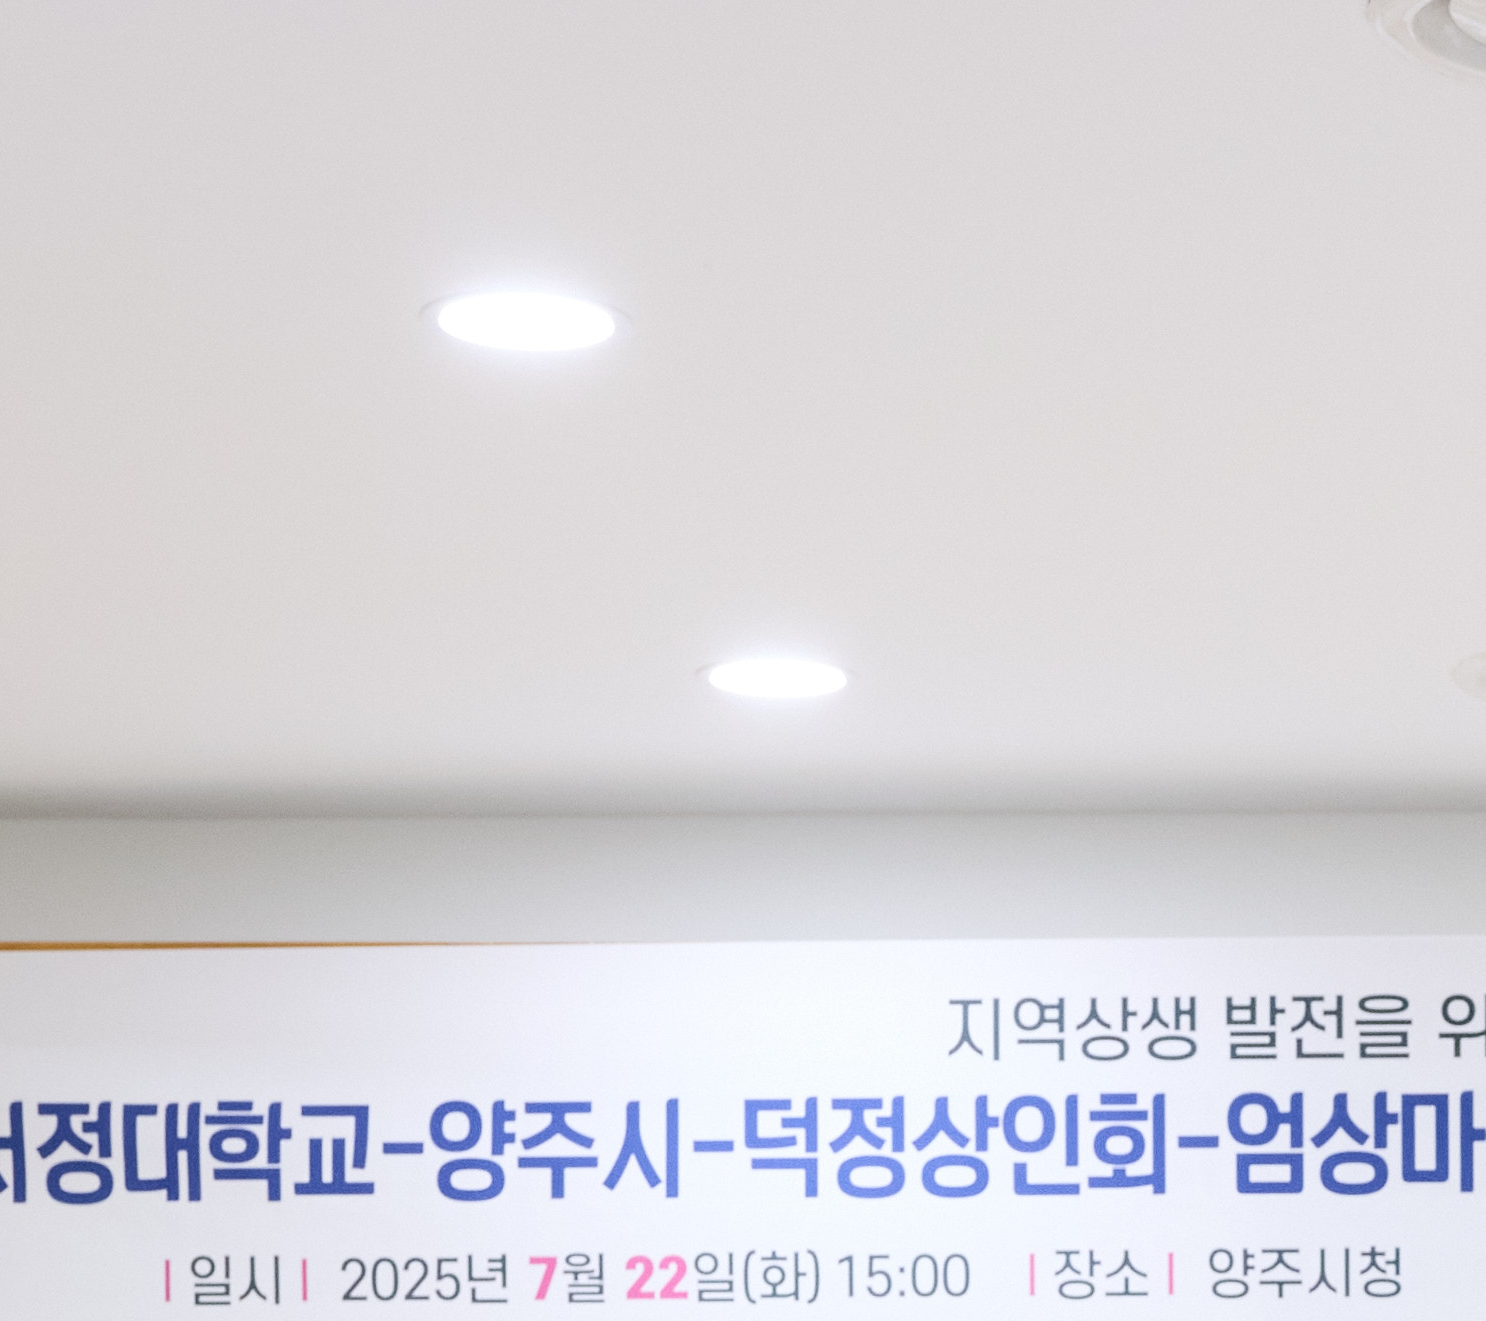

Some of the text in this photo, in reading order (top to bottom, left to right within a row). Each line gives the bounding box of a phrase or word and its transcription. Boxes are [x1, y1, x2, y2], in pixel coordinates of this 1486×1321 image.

[946, 994, 1200, 1063] 지역상생
[1223, 992, 1416, 1062] 발전을
[188, 1244, 1404, 1308] 일시 2025년 7월 22일(화) 15:00 장소 양주시청
